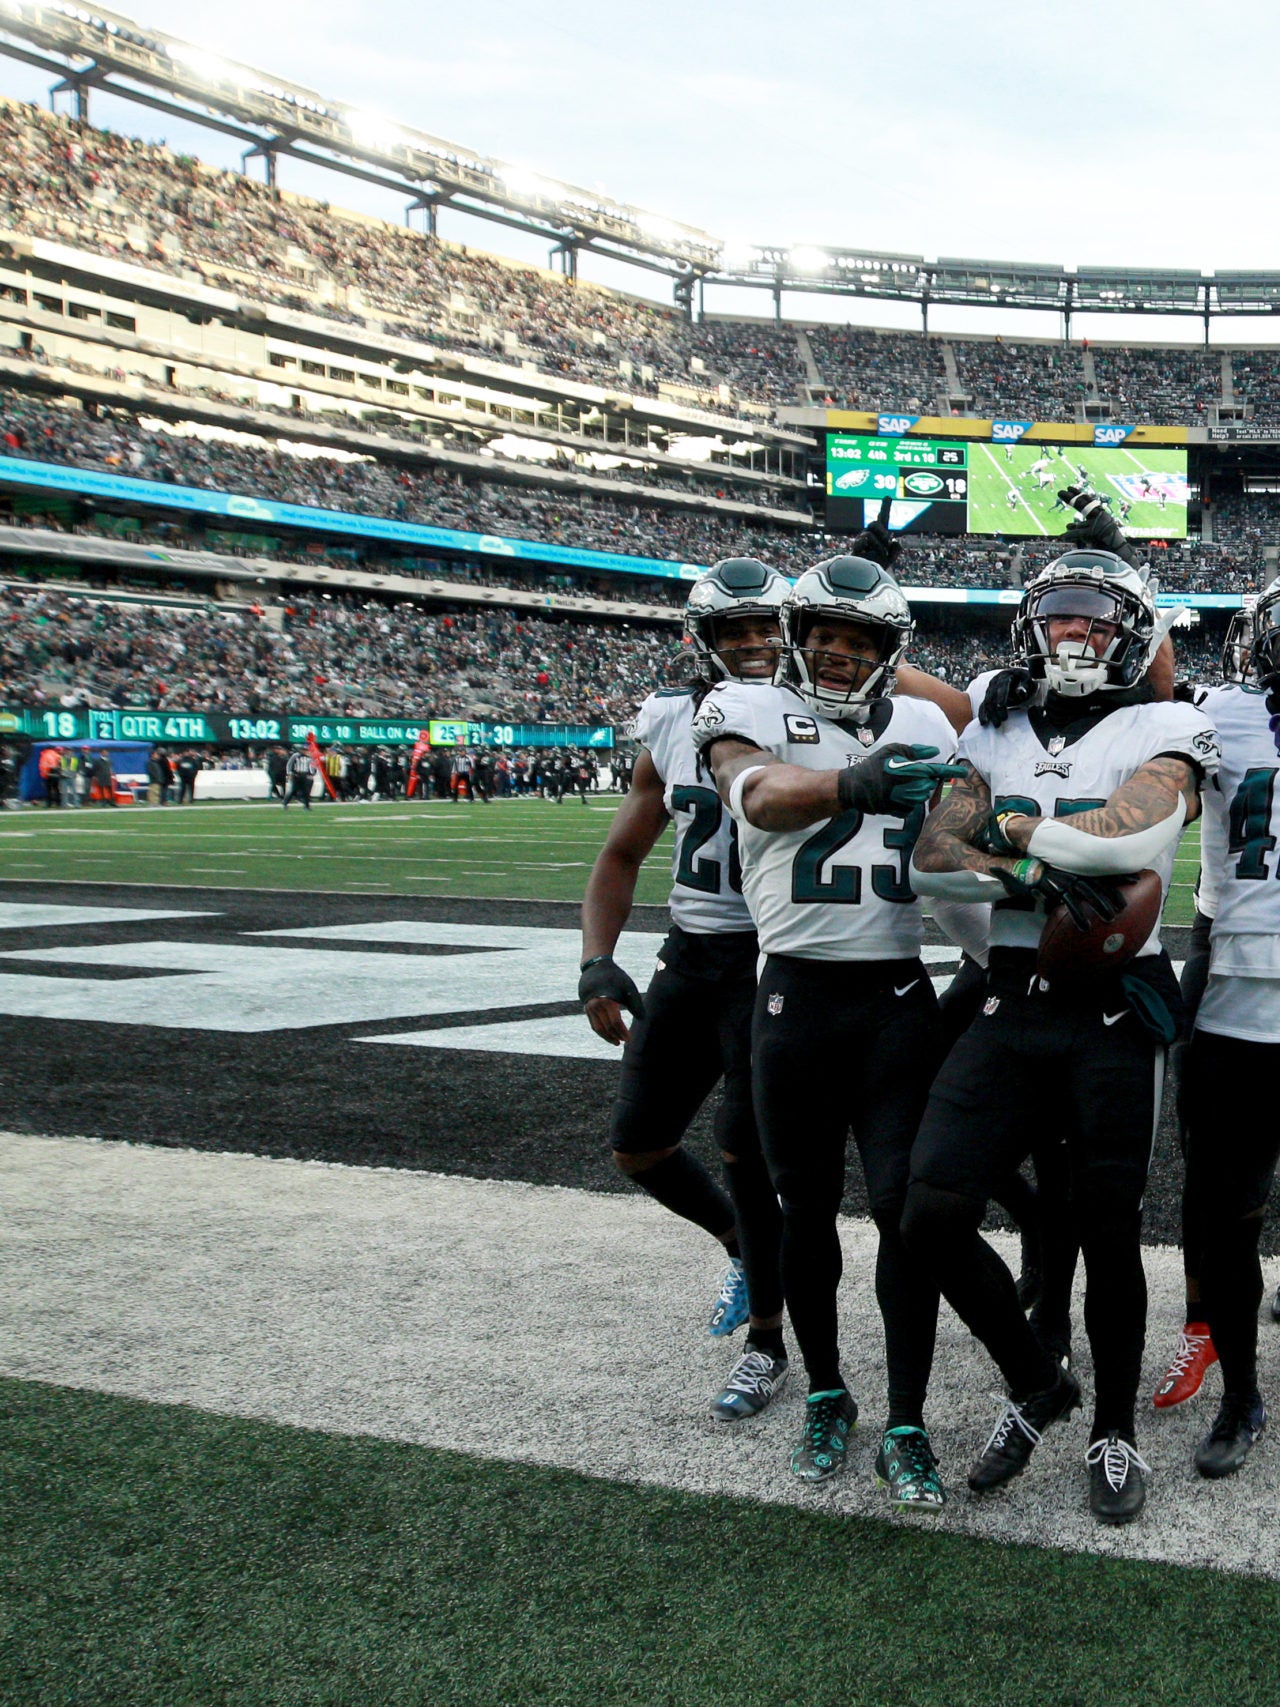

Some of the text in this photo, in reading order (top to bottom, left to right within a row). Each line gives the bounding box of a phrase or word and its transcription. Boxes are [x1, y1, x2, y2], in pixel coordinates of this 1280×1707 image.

[878, 417, 911, 433] SAP
[992, 424, 1024, 440] SAP
[1094, 428, 1126, 443] SAP
[831, 447, 862, 459] 13:02
[868, 450, 887, 460] 4th
[893, 451, 911, 462] 3rd
[922, 453, 936, 463] 10
[874, 474, 897, 490] 30
[945, 478, 967, 494] 18
[43, 712, 76, 738] 18
[99, 723, 112, 738] 2
[121, 716, 205, 738] QTR 4TH
[228, 719, 280, 740] 13:02
[336, 725, 350, 738] 10
[360, 726, 386, 739] BALL
[387, 727, 402, 739] ON
[786, 714, 817, 736] C
[472, 732, 480, 743] 2
[494, 726, 514, 744] 30
[1034, 761, 1074, 779] EAGLES
[713, 1308, 725, 1325] 2
